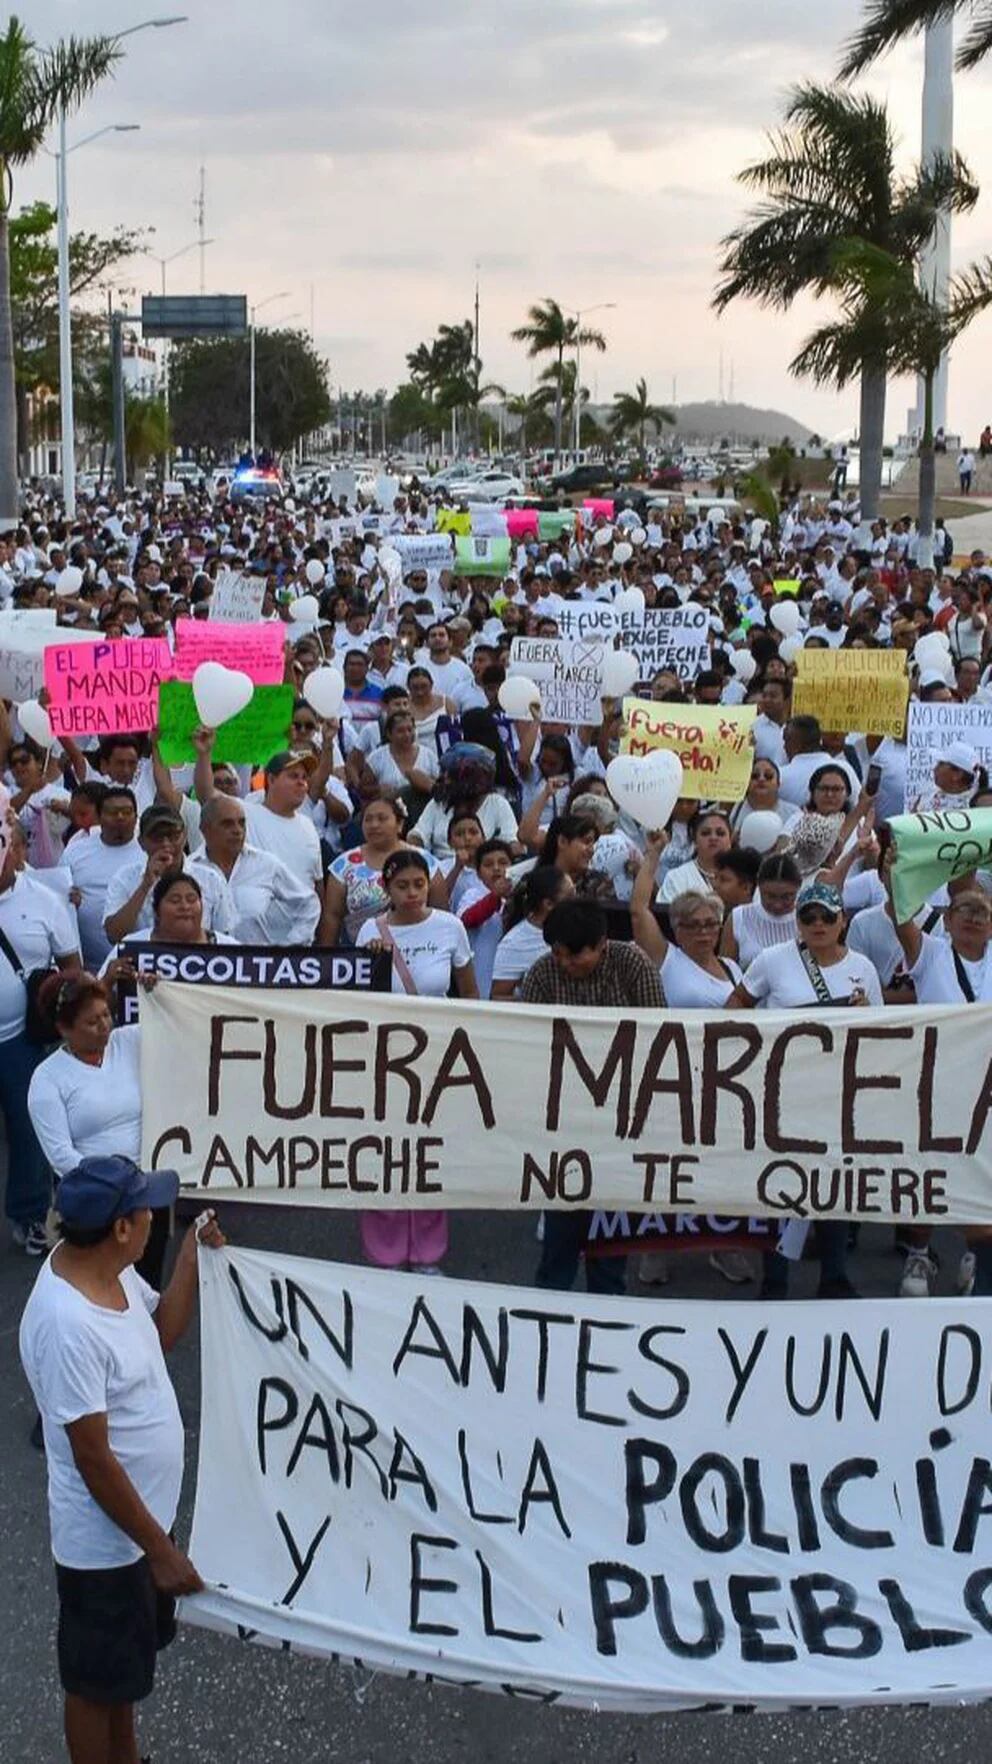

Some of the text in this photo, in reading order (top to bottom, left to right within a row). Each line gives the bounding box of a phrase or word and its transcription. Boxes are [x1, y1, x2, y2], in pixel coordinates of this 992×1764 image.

[622, 611, 706, 629] EL PUEBLO
[55, 650, 79, 671] EL
[67, 670, 161, 700] MANDA
[49, 706, 110, 732] FUERA
[916, 809, 970, 833] NO
[138, 953, 372, 985] ESCOLTAS DE
[208, 1014, 496, 1130] FUERA
[151, 1126, 444, 1194] CAMPECHE
[520, 1149, 592, 1203] NO
[632, 1152, 700, 1206] TE
[228, 1262, 354, 1373] UN
[392, 1294, 690, 1428] ANTES
[717, 1327, 769, 1425] Y
[785, 1326, 890, 1422] UN
[257, 1375, 438, 1513] PARA
[457, 1428, 573, 1539] LA
[275, 1509, 332, 1606] Y
[410, 1532, 544, 1643] EL
